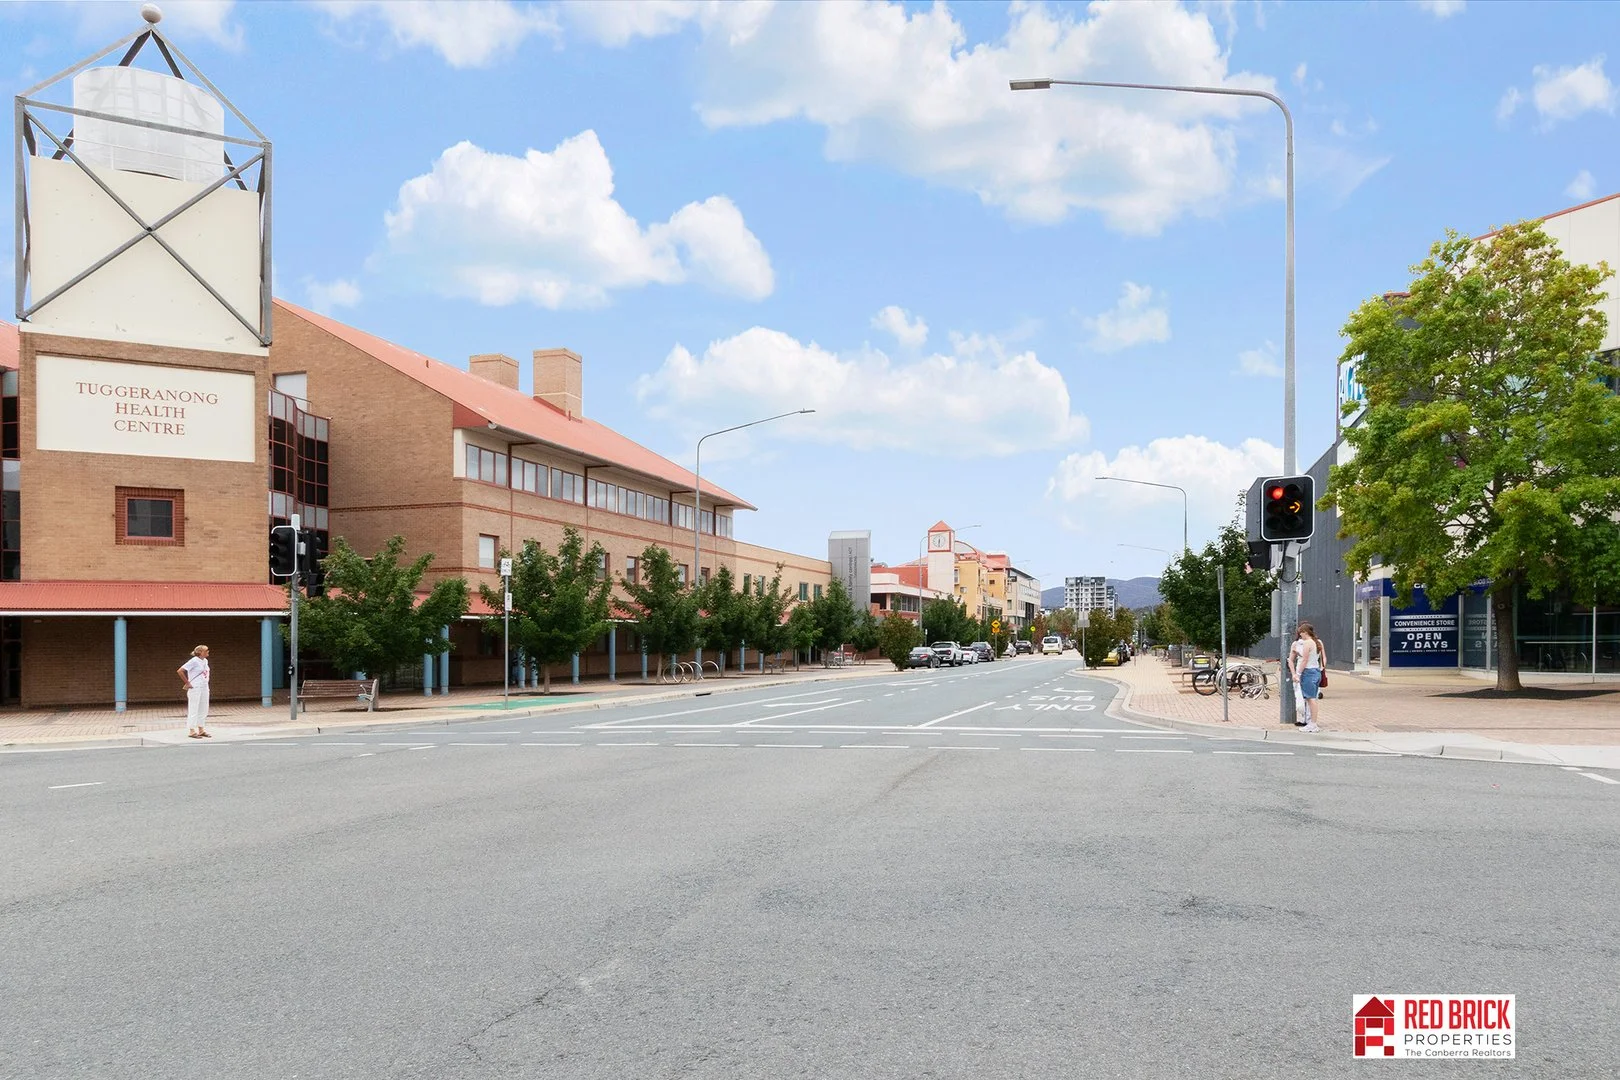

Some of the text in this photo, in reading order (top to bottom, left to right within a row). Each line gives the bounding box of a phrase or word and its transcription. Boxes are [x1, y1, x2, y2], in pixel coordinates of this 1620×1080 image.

[76, 382, 218, 404] TUGGERANONG
[116, 403, 185, 419] HEALTH
[114, 420, 185, 436] CENTRE
[994, 704, 1096, 712] ONLY
